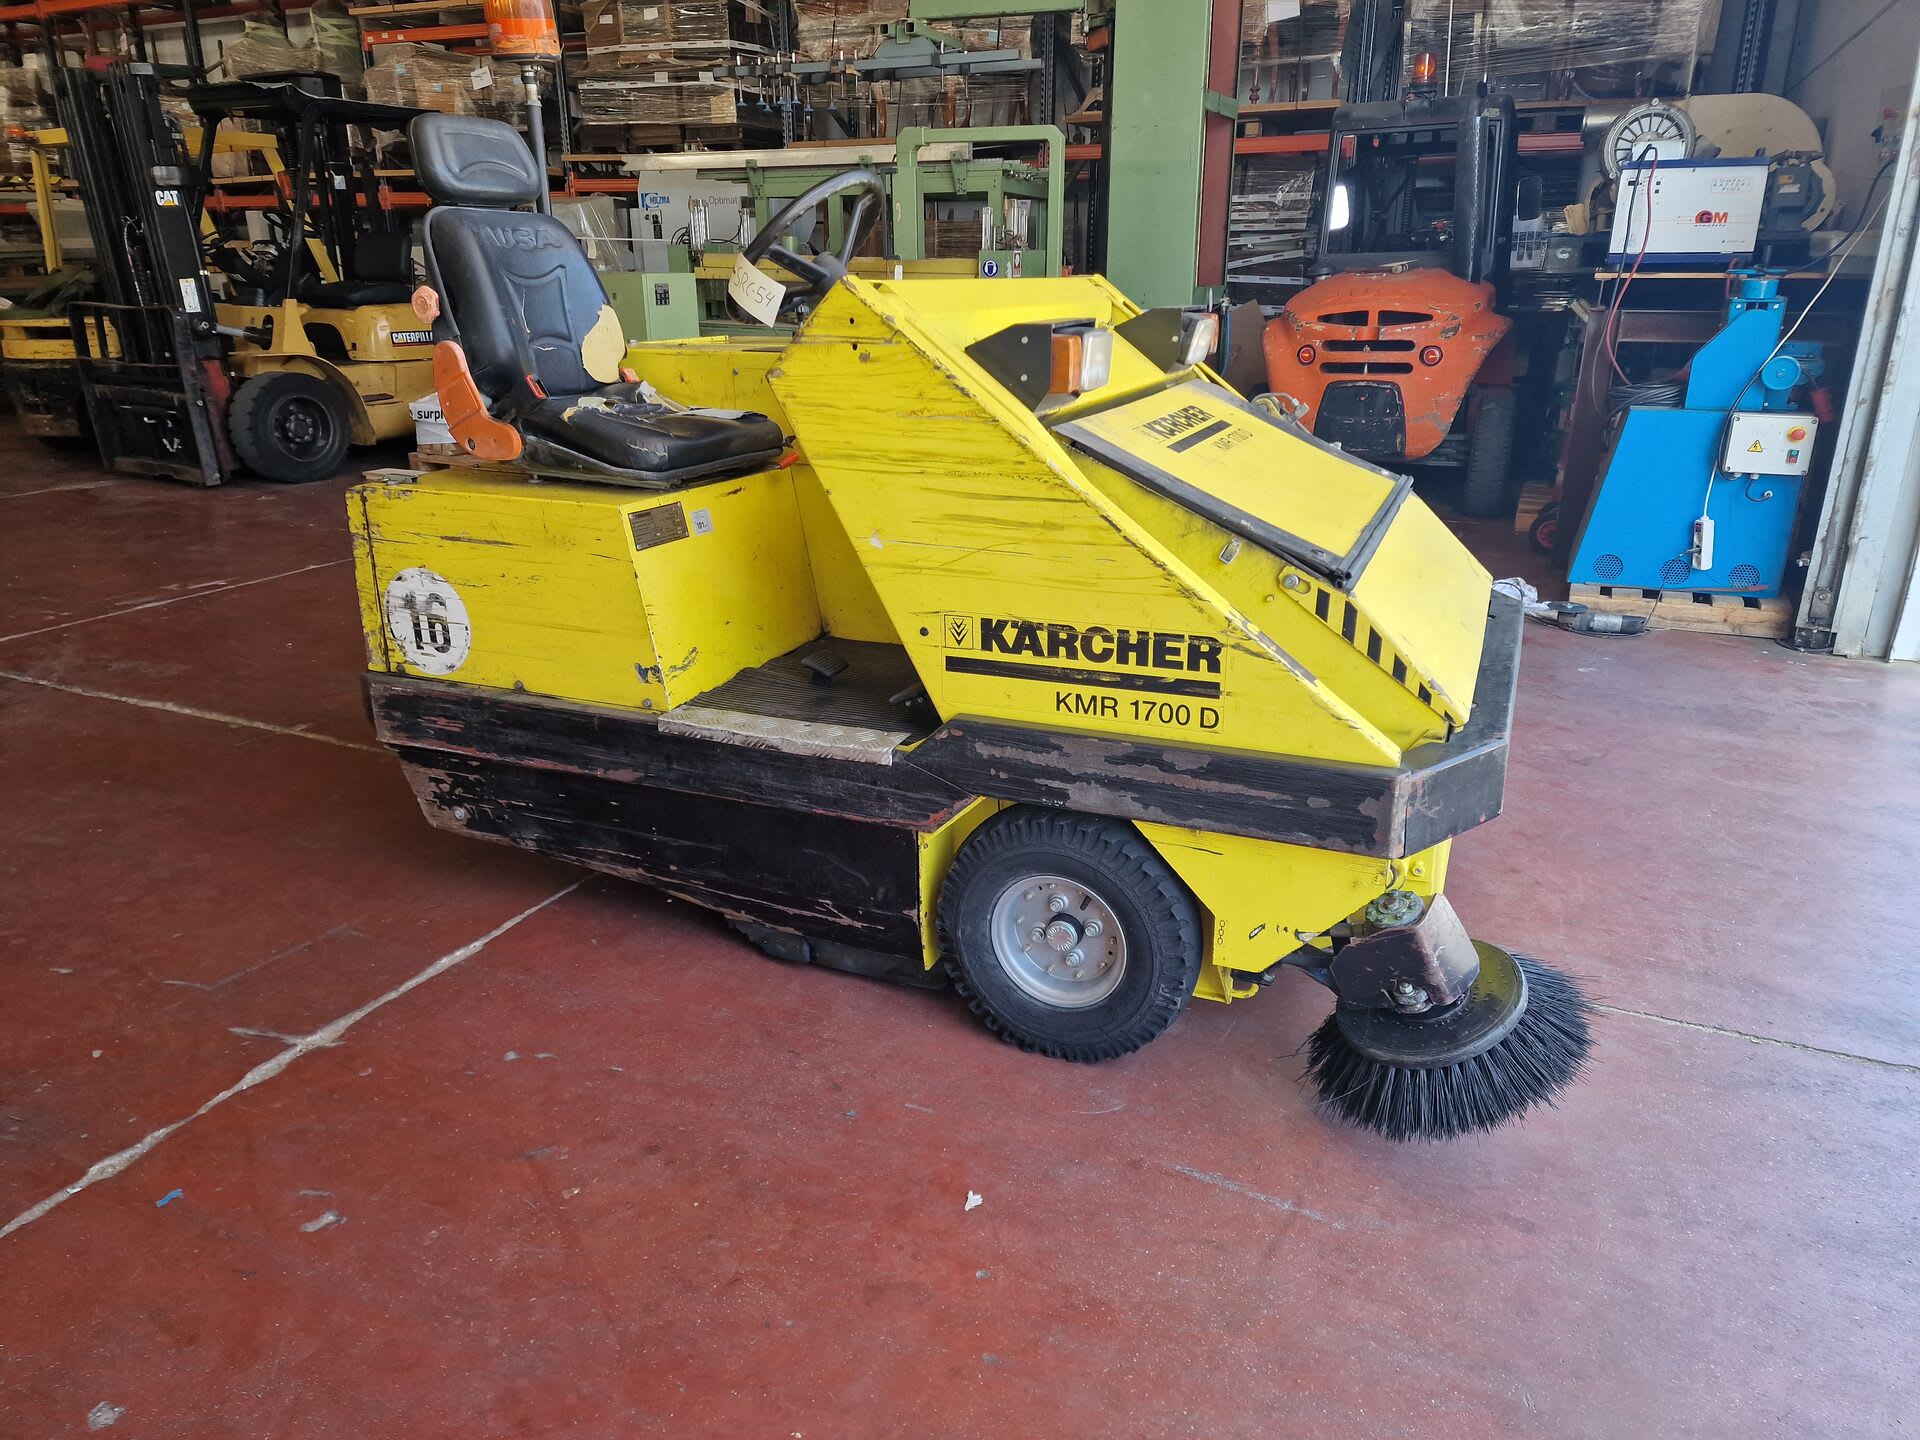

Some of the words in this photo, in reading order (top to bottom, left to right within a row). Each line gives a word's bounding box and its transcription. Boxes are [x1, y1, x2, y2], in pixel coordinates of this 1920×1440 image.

[155, 190, 179, 206] CAT
[650, 196, 670, 205] HOLZMA
[709, 195, 738, 207] Optimat
[1142, 405, 1215, 439] KÄRCHER
[980, 617, 1222, 674] KÄRCHER
[1056, 691, 1119, 718] KMR
[1130, 700, 1191, 727] 1700
[1200, 707, 1220, 729] D
